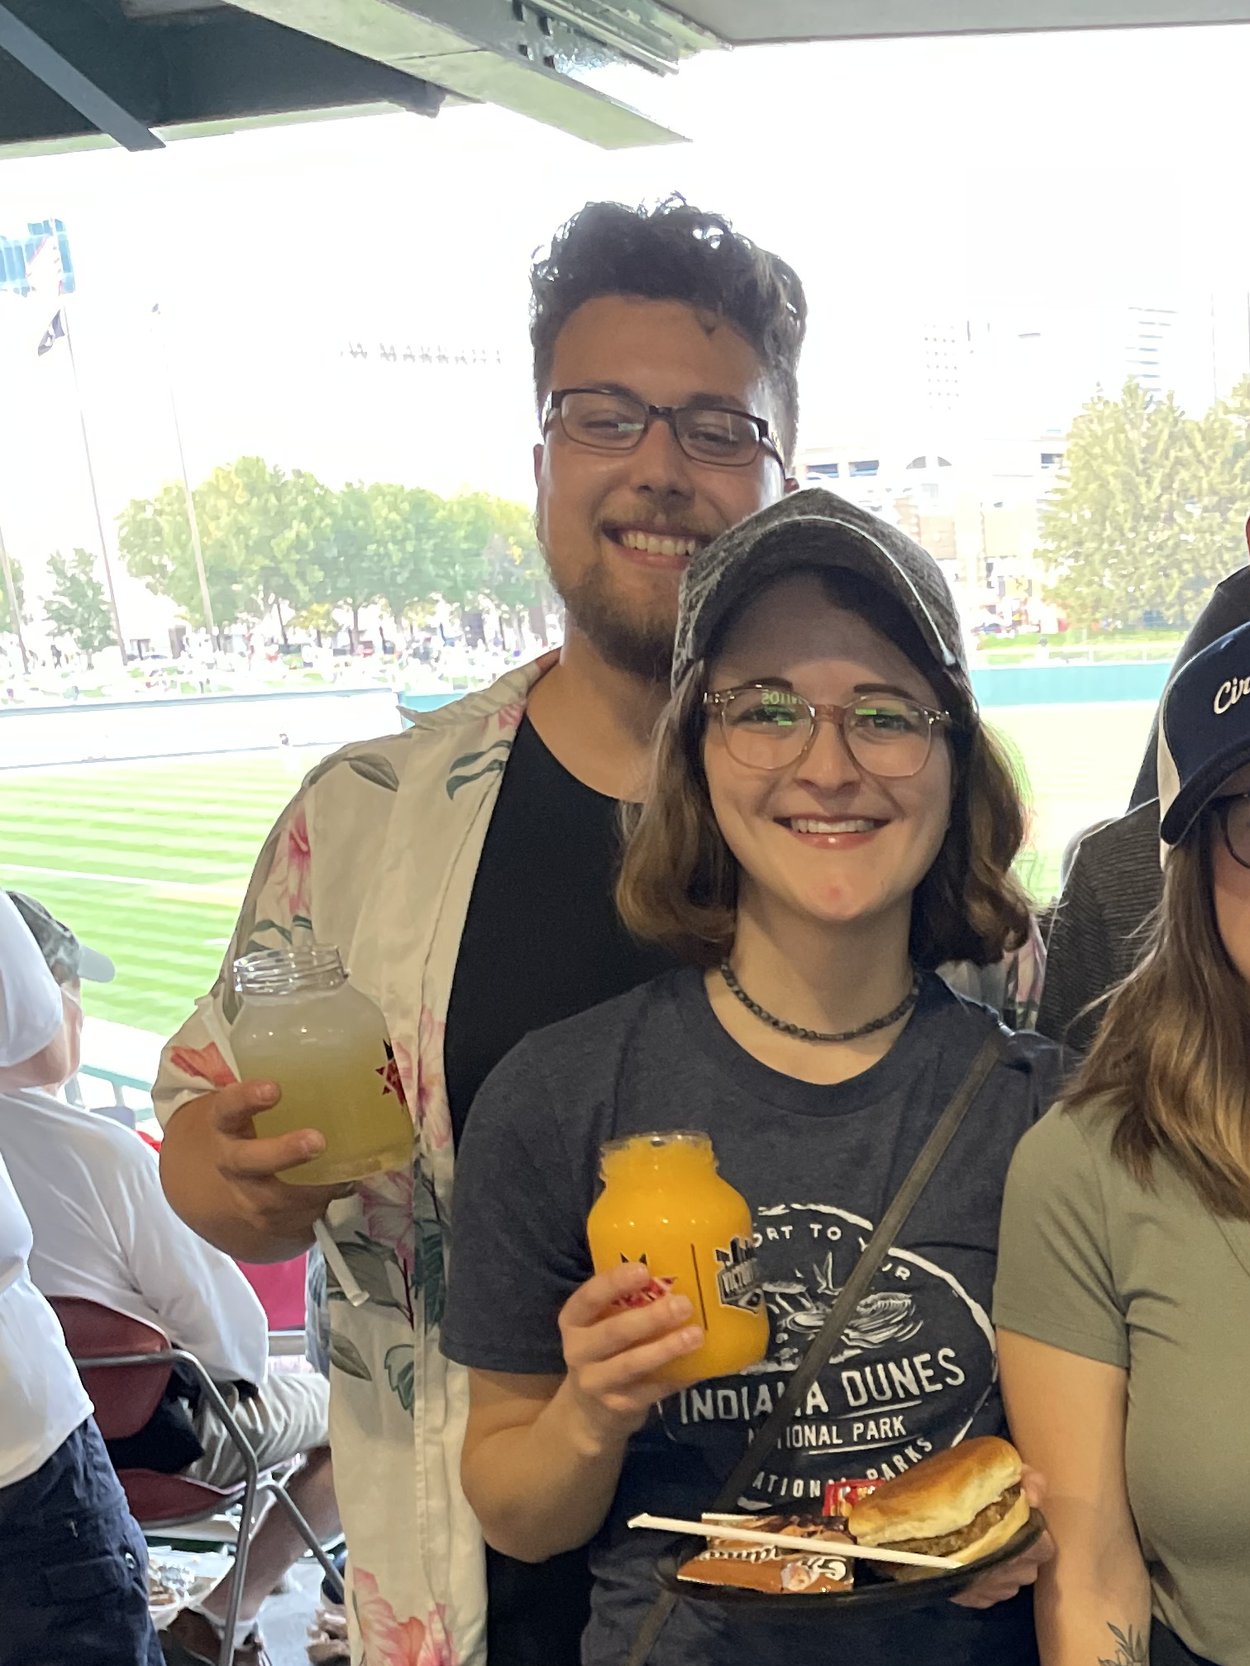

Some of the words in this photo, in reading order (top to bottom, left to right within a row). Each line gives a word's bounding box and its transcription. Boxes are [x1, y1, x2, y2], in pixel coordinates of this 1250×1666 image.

[809, 1223, 842, 1241] TO
[679, 1380, 829, 1425] INDIAA
[841, 1347, 966, 1408] DUNES
[853, 1415, 908, 1442] PARK
